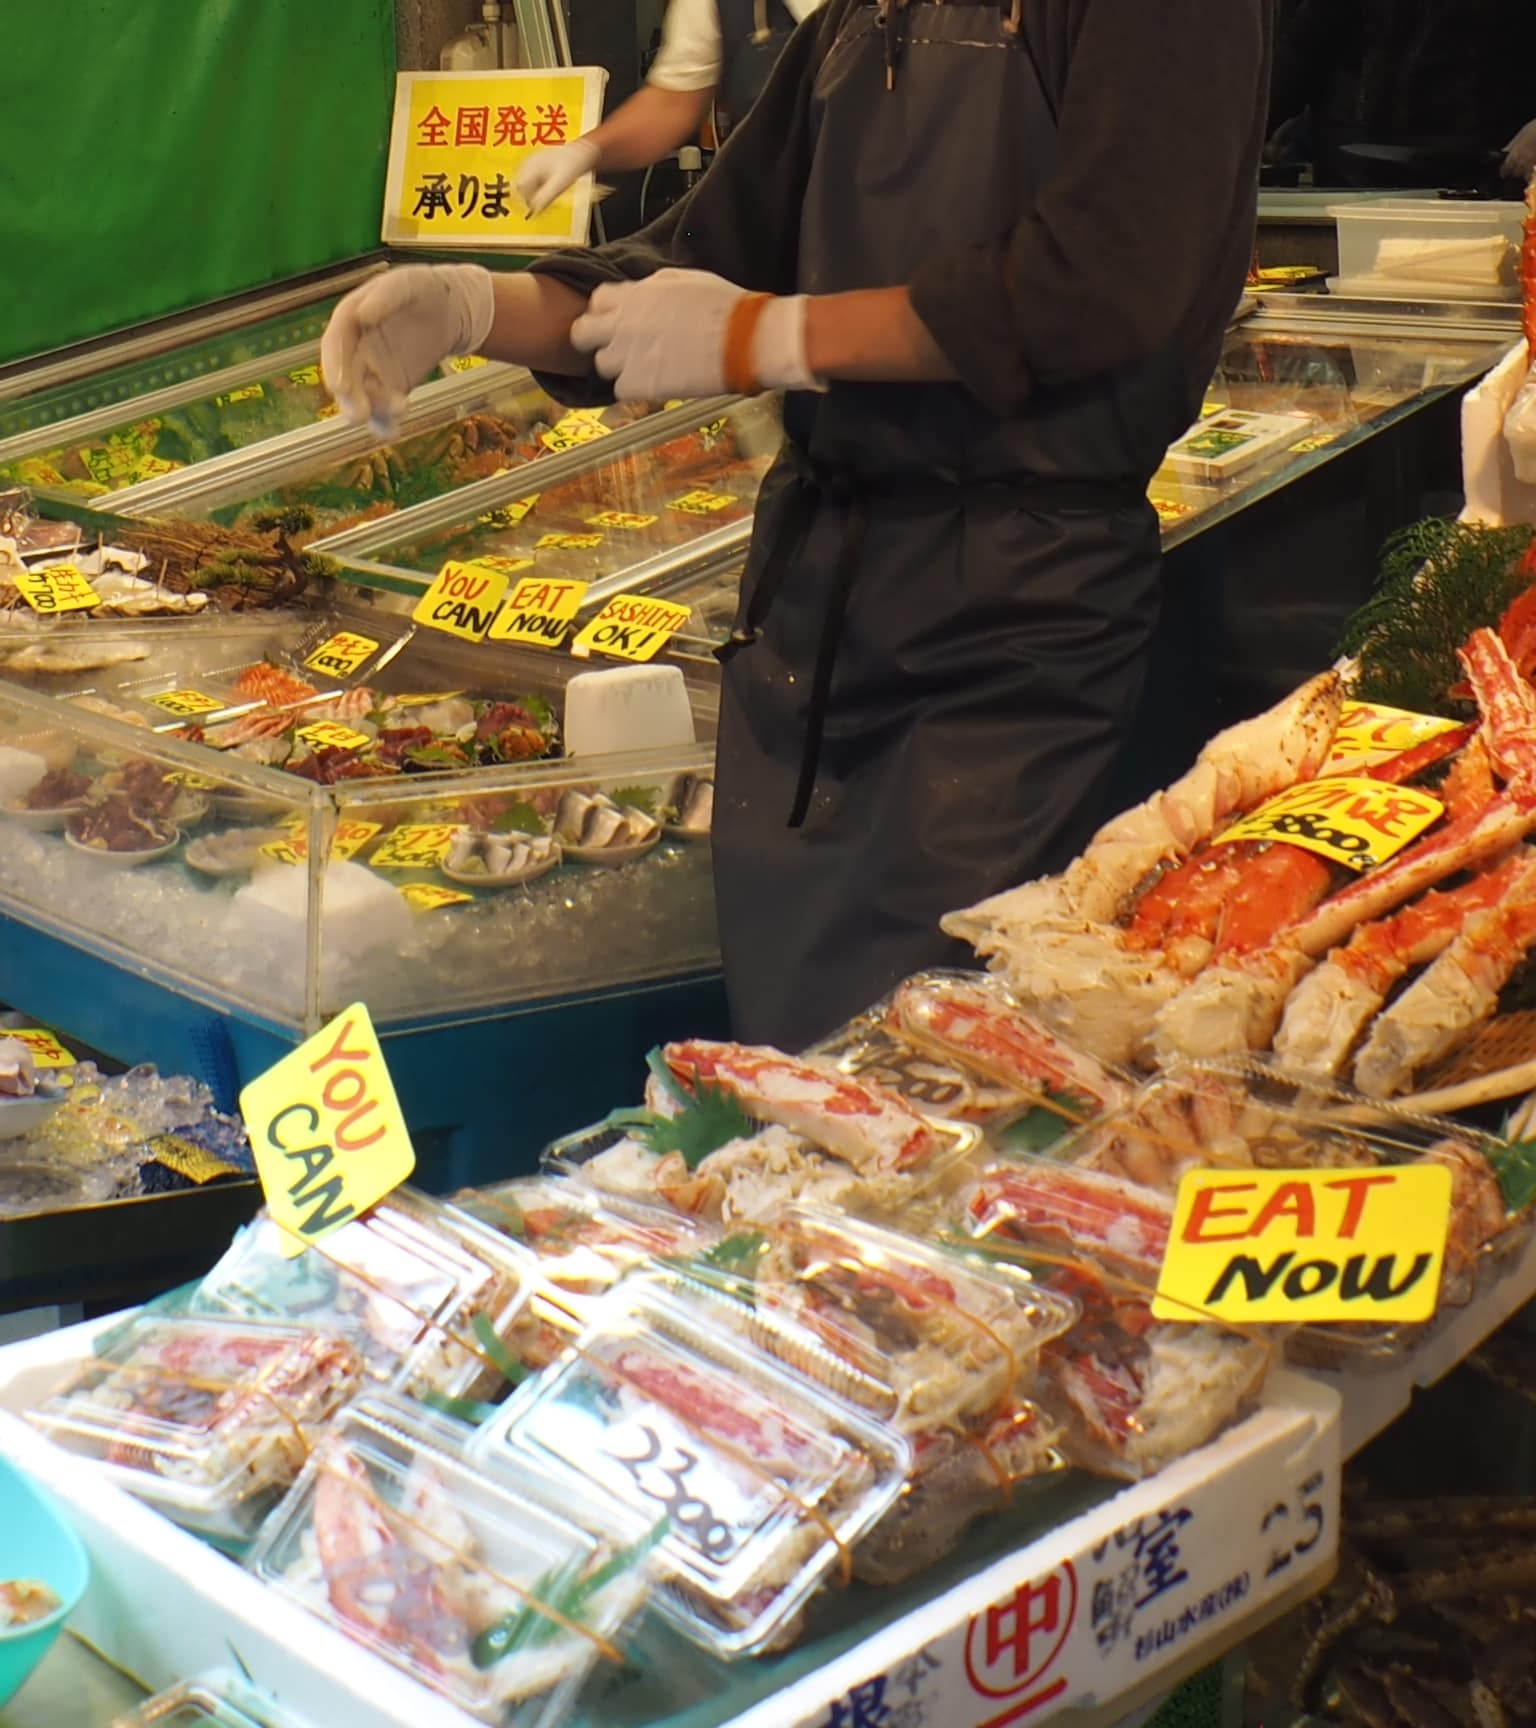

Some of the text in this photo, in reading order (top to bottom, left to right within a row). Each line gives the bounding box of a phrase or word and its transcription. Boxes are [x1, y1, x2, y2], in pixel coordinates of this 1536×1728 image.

[417, 105, 568, 147] 全国発送
[413, 173, 512, 221] 承りま
[437, 568, 490, 601] YOU
[510, 584, 574, 612] EAT
[432, 600, 495, 634] CAN
[507, 613, 568, 639] NOW
[600, 600, 689, 632] SASHIMI
[592, 625, 655, 656] OK!
[310, 1020, 386, 1150] YOU
[267, 1103, 355, 1235] CAN
[1181, 1175, 1397, 1243] EAT
[1204, 1251, 1433, 1306] NOW
